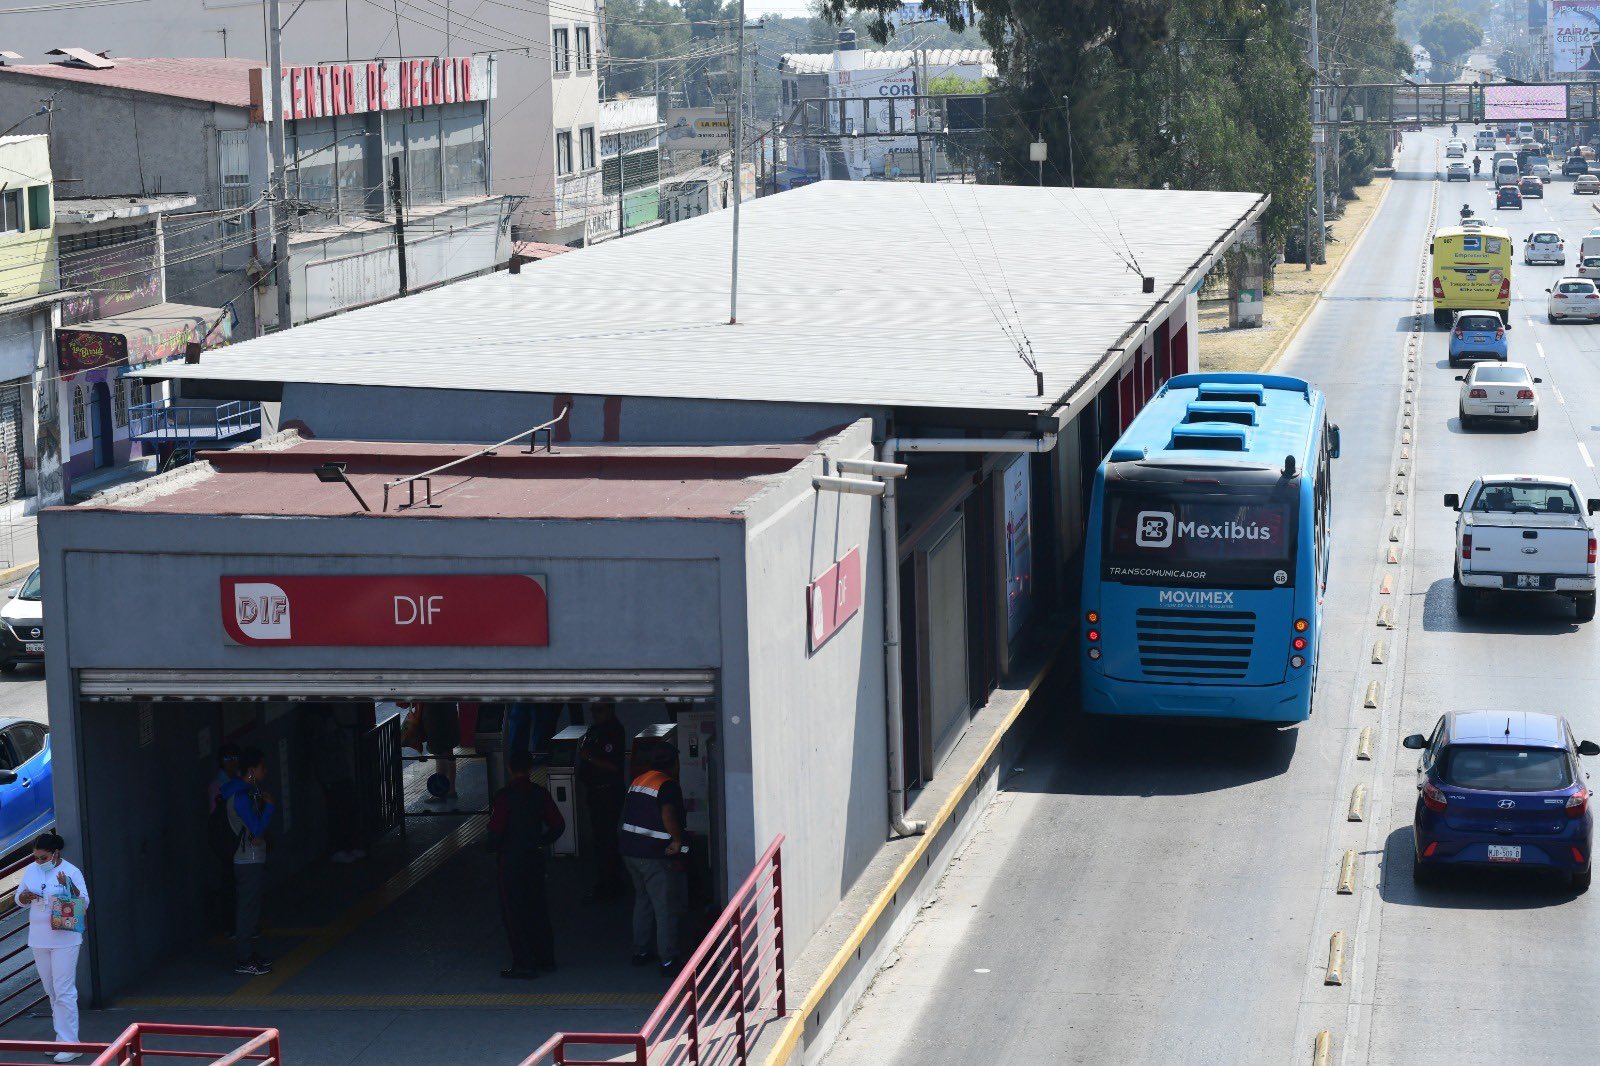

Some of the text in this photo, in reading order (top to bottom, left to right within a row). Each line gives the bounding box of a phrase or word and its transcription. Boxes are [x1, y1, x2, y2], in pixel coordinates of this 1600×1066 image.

[400, 56, 471, 109] NEGOCIO
[1177, 521, 1271, 540] Mexibús
[1109, 567, 1207, 579] TRANSCOMUNICADOR
[1159, 590, 1234, 604] MOVIMEX
[239, 595, 444, 625] DIF DIF
